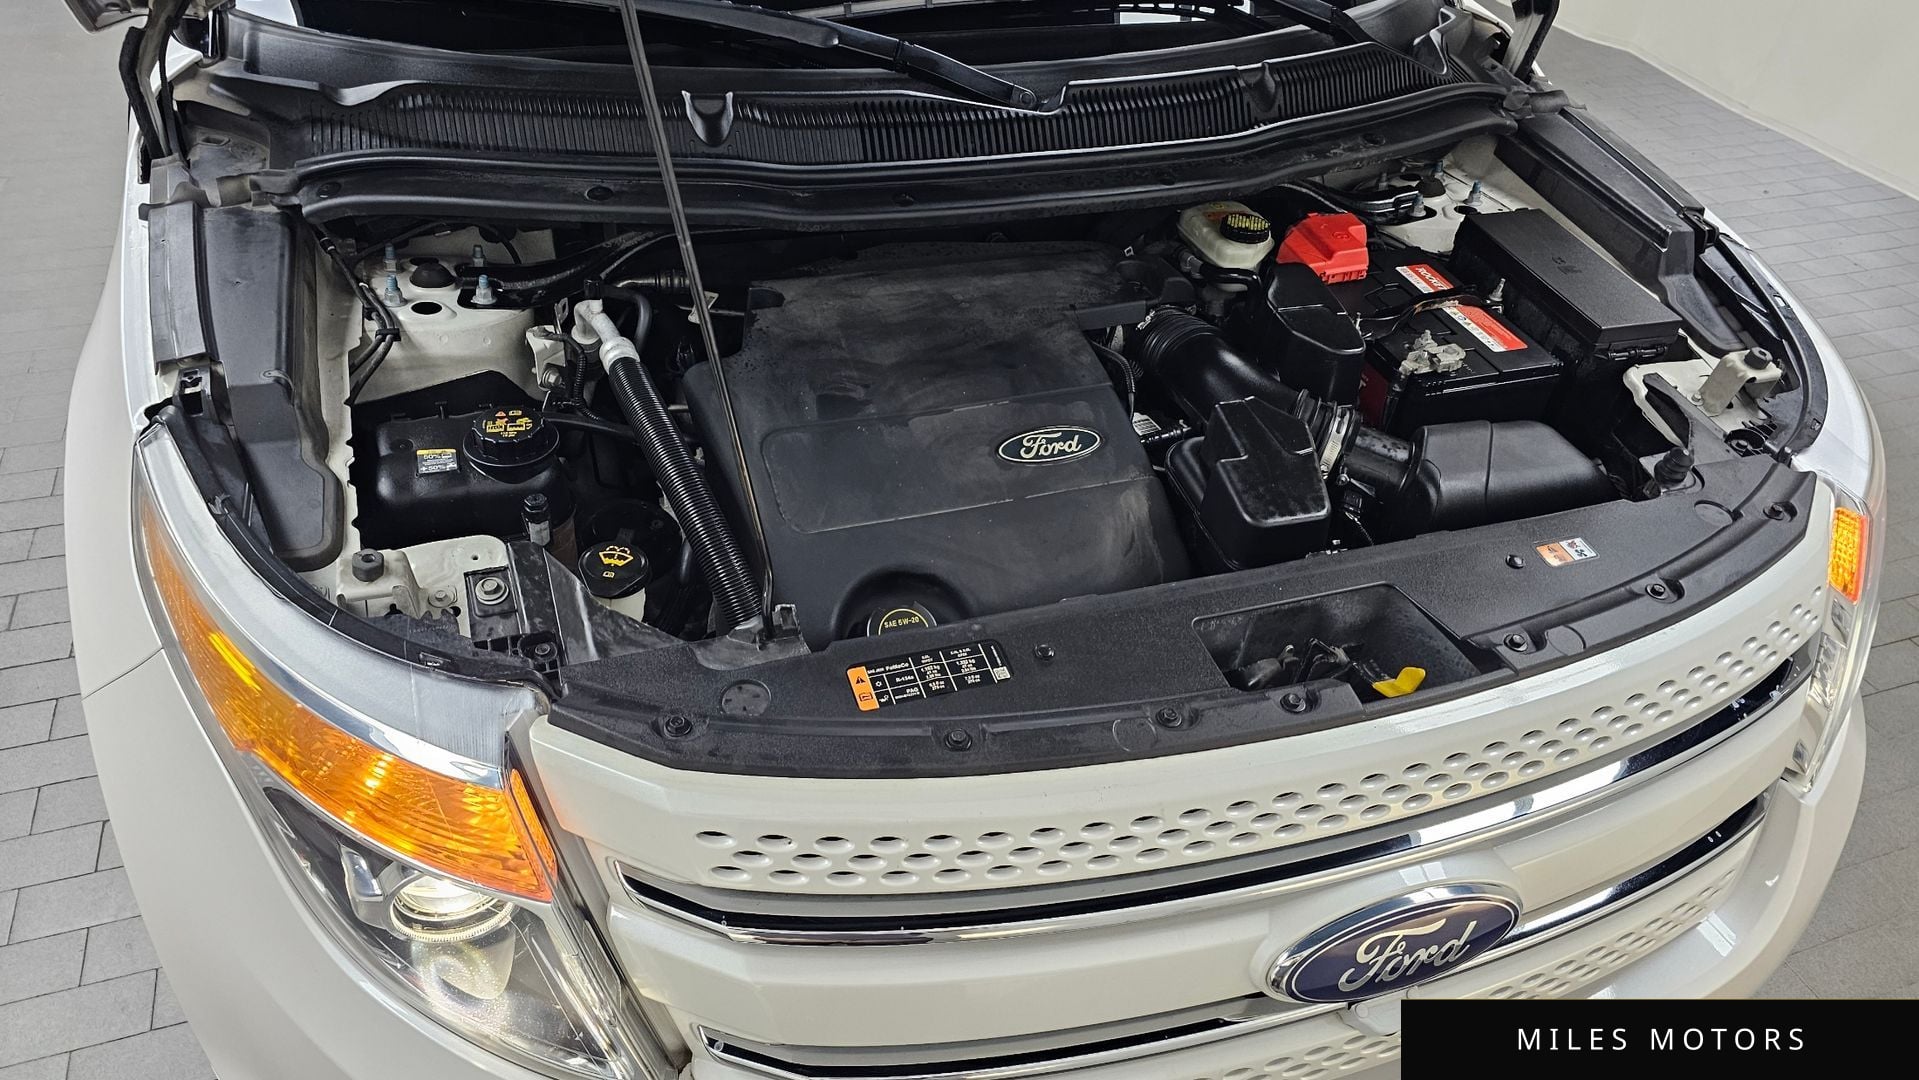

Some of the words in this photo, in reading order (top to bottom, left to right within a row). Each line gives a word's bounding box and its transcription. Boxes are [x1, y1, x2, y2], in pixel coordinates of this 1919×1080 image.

[1020, 431, 1082, 459] Ford
[884, 619, 898, 629] SAE
[898, 616, 920, 626] 5W-20
[1338, 918, 1478, 992] Ford
